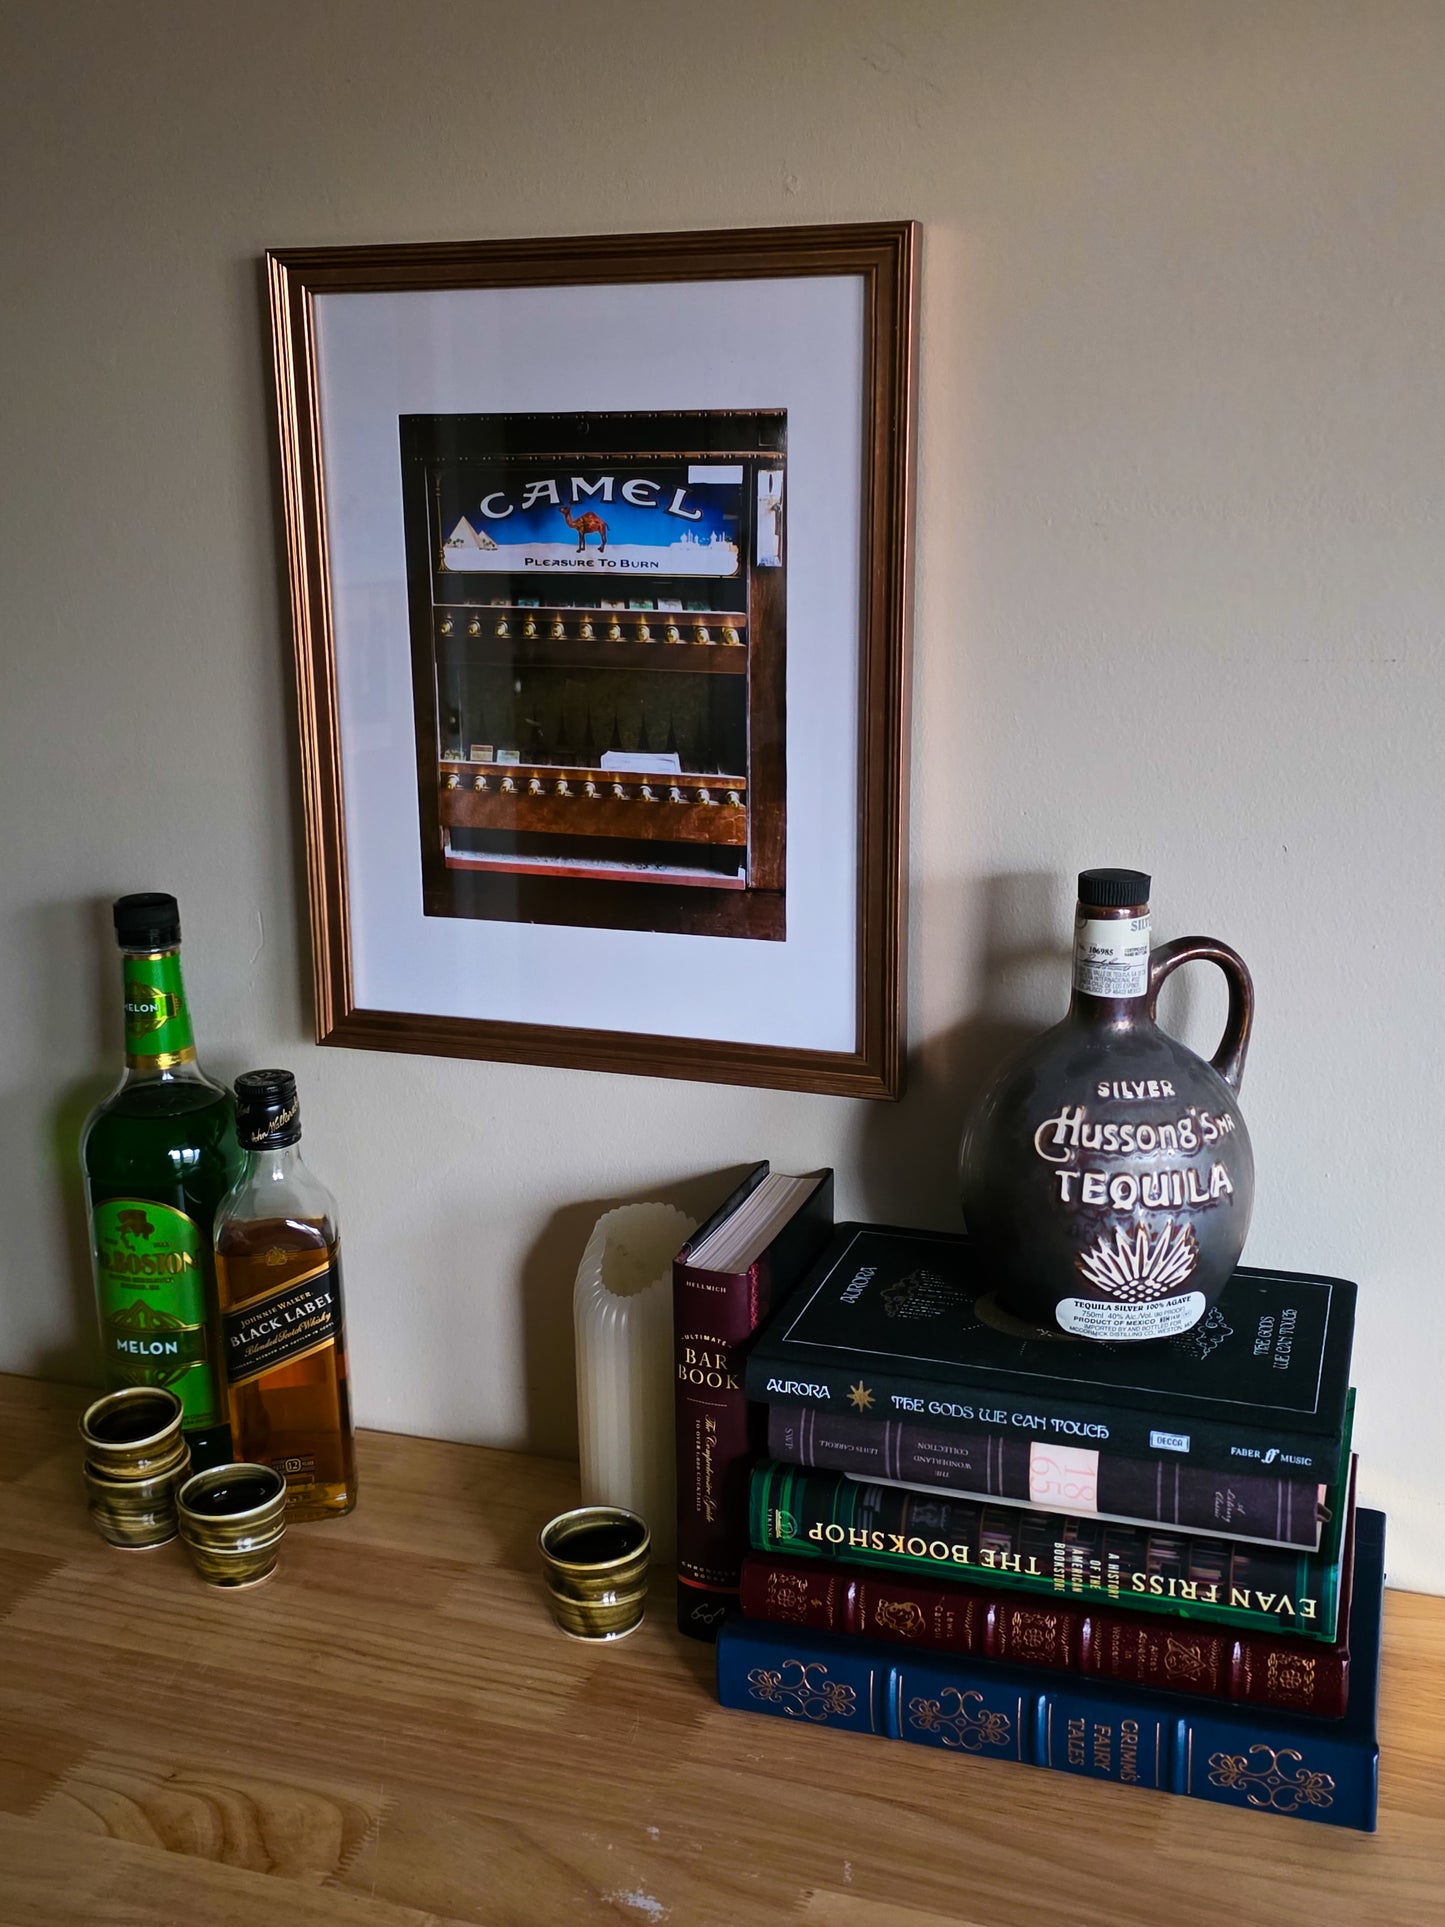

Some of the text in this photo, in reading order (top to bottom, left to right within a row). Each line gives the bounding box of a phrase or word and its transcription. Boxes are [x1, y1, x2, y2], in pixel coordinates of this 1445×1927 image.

[479, 476, 702, 520] CAMEL
[1097, 1079, 1176, 1099] SILVER
[1055, 1160, 1234, 1210] TEQUILA
[686, 1281, 727, 1293] HELLMICH
[840, 1267, 877, 1304] AURORA
[1073, 1300, 1112, 1311] TEQUILA
[1114, 1304, 1144, 1312] SILVER
[1166, 1296, 1192, 1307] AGAVE
[1081, 1310, 1104, 1319] 750ml
[230, 1316, 282, 1348] BLACK
[284, 1292, 335, 1323] LABEL
[240, 1306, 277, 1329] JOHNNIE
[1073, 1316, 1111, 1326] PRODUCT
[1126, 1318, 1156, 1326] MEXICO
[116, 1339, 178, 1355] MELON
[684, 1334, 727, 1347] ULTIMATE
[685, 1348, 728, 1370] BAR
[678, 1364, 740, 1390] BOOK
[766, 1378, 831, 1400] AURORA
[891, 1395, 1109, 1440] THE GODS WE CAN TOUCH
[917, 1442, 969, 1456] COLLECTION
[1157, 1435, 1183, 1447] DECCA
[287, 1460, 298, 1470] 12
[913, 1455, 972, 1470] WONDERLAND
[1230, 1446, 1260, 1459] FABER
[1280, 1454, 1313, 1466] MUSIC
[808, 1522, 1042, 1578] THE BOOKSHOP
[1053, 1542, 1066, 1592] BOOKSTORE
[1071, 1548, 1083, 1593] AMERICAN
[1089, 1559, 1102, 1590] OF THE
[1107, 1552, 1120, 1600] A HISTORY
[1131, 1572, 1317, 1619] EVAN FRISS
[1068, 1717, 1085, 1766] TALES
[1093, 1723, 1112, 1772] FAIRY
